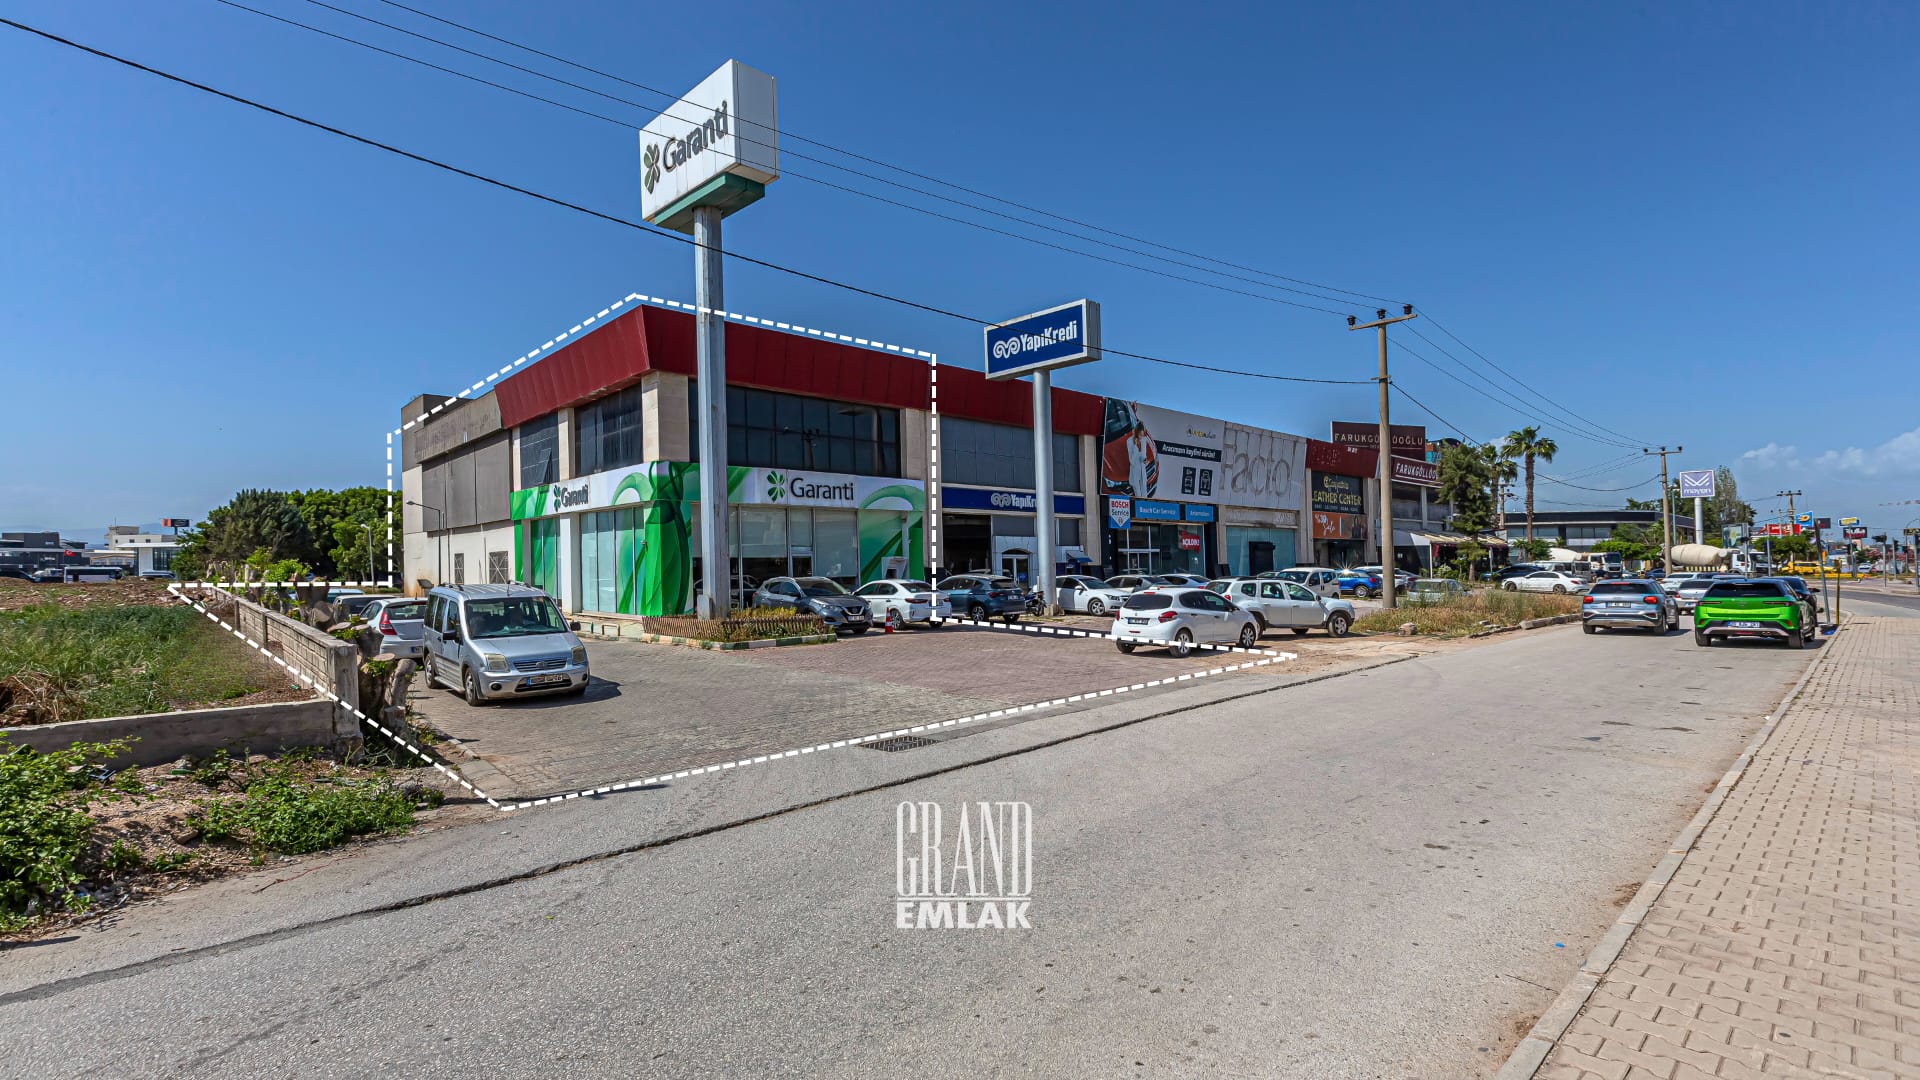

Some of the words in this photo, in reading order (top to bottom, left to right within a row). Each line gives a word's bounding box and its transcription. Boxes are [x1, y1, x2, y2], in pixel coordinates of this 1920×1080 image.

[662, 99, 729, 173] Garanti
[560, 484, 589, 507] Garanti
[790, 477, 854, 501] Garanti
[1111, 500, 1129, 508] BOSCH
[1338, 493, 1362, 506] CENTER
[1111, 508, 1129, 516] Service
